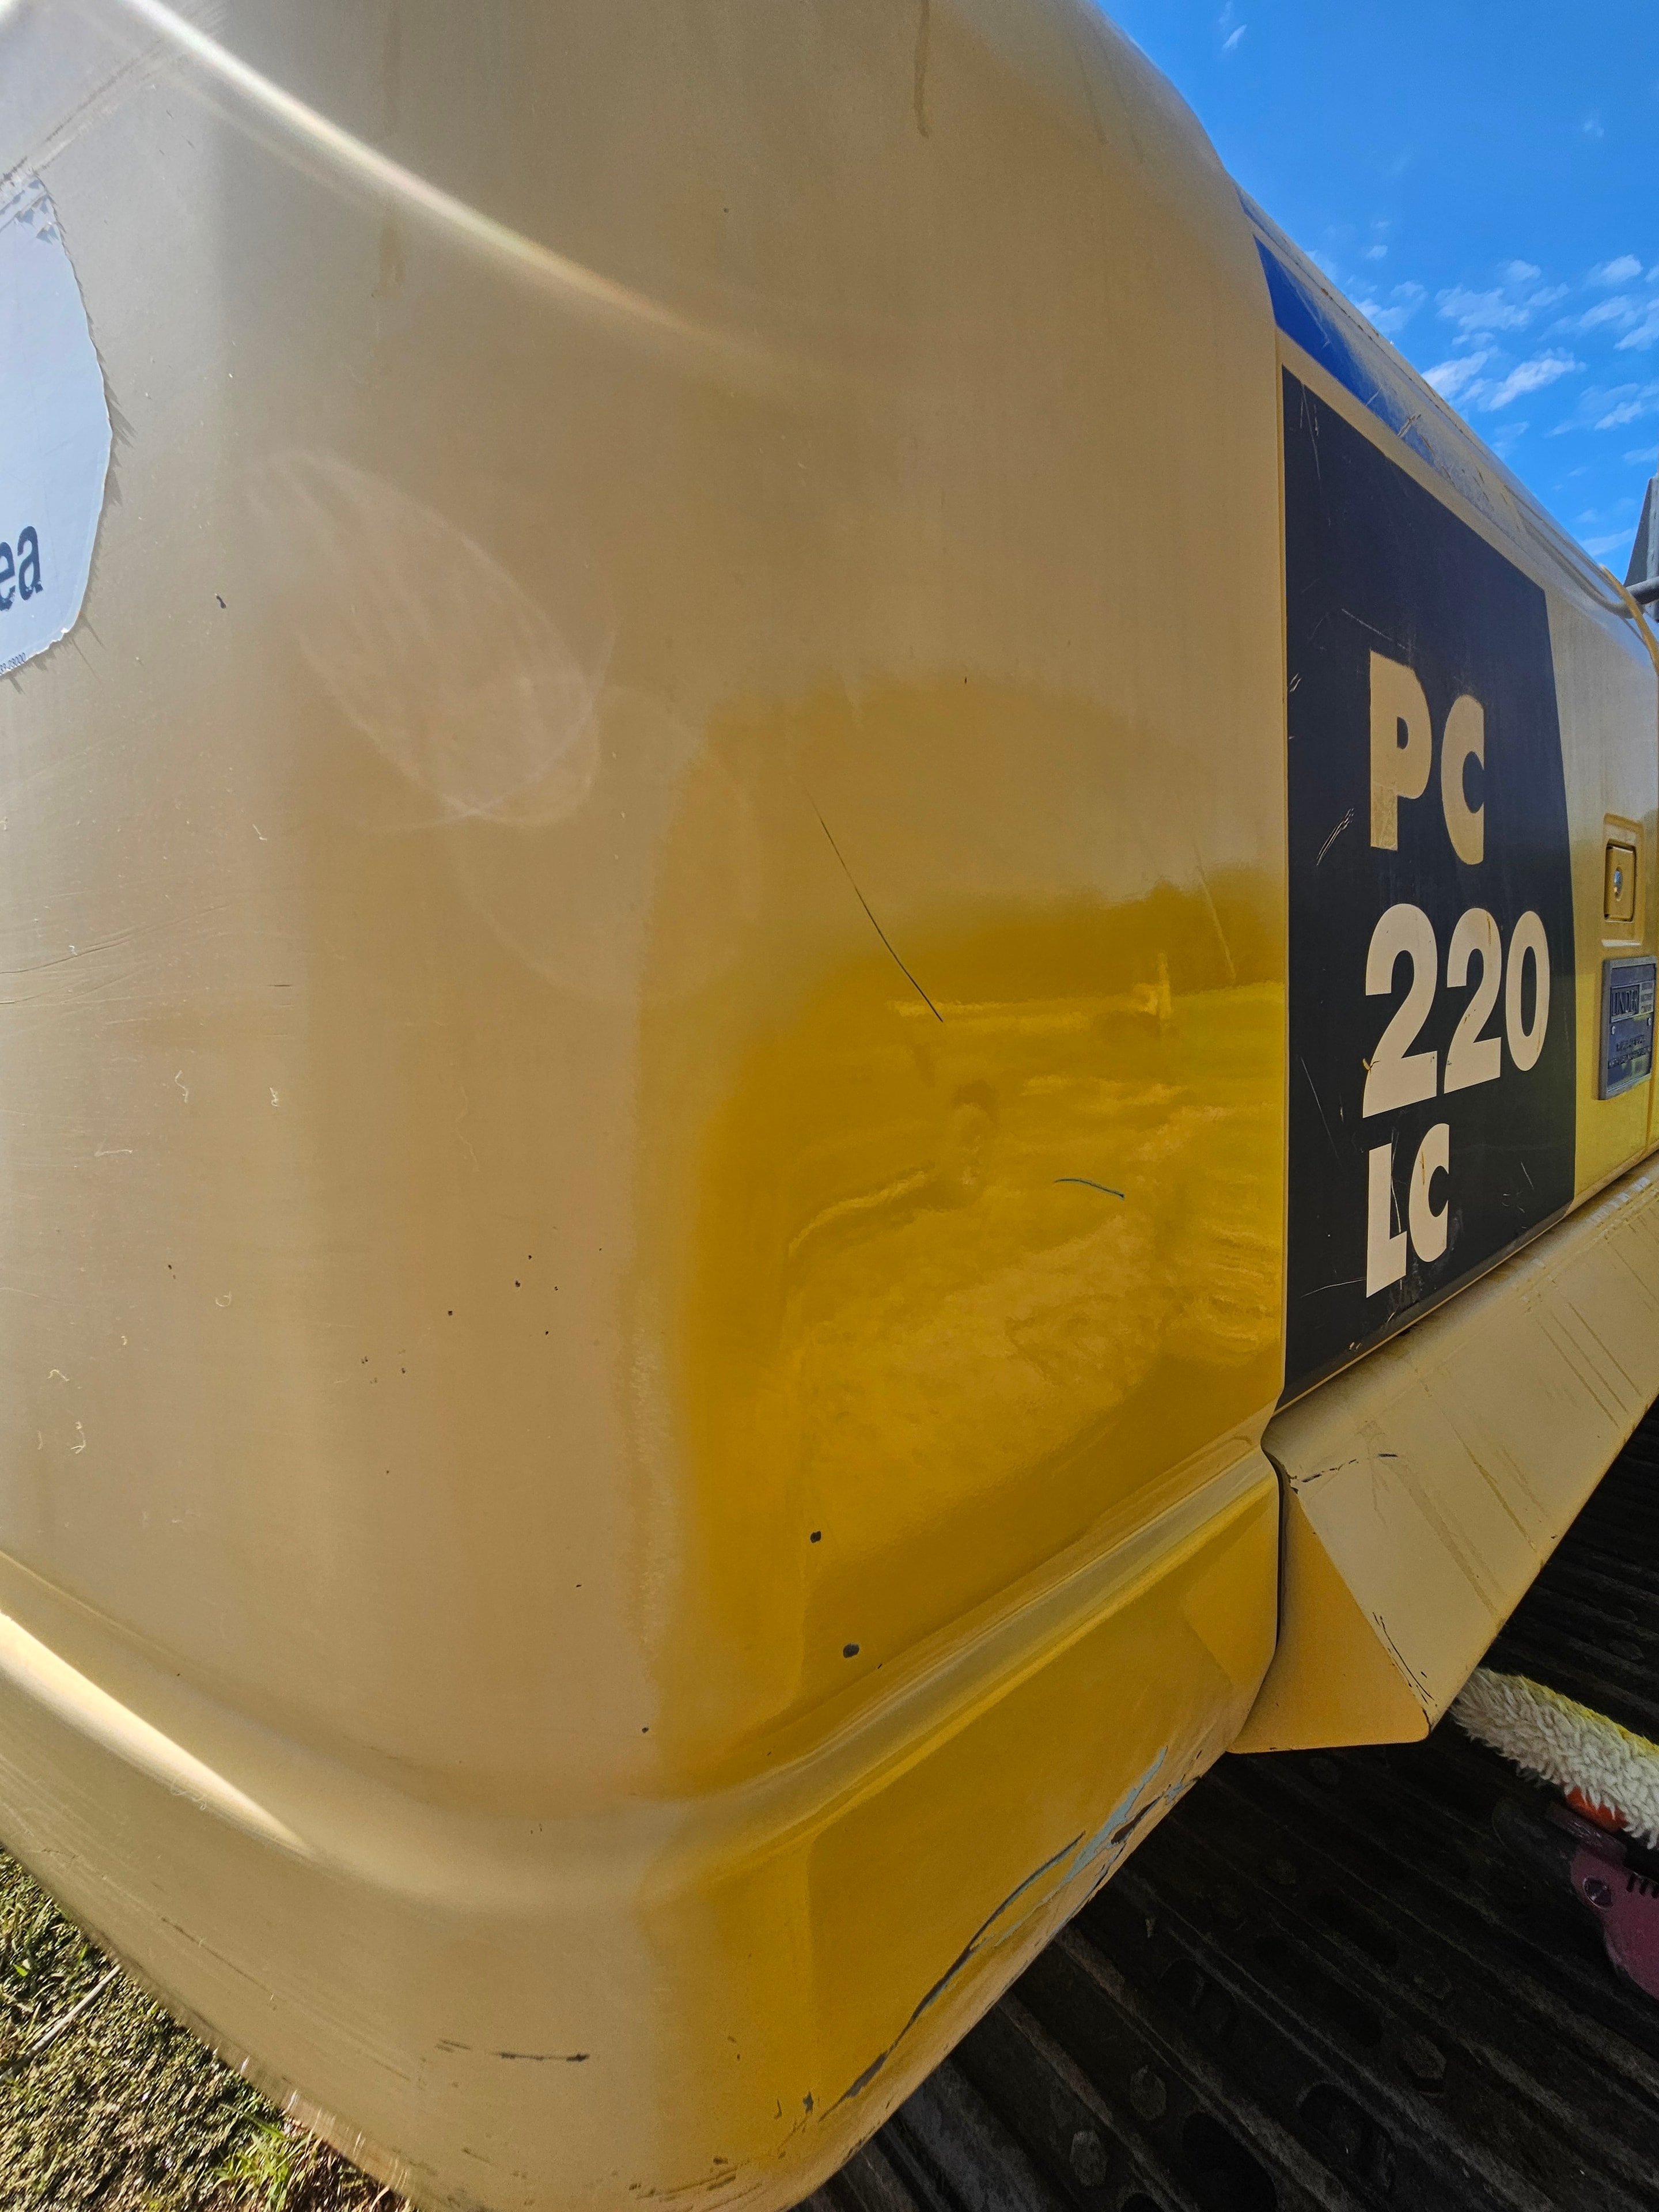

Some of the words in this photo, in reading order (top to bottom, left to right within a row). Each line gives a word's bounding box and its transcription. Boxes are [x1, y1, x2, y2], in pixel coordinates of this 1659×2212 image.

[1370, 649, 1485, 865] PC
[1362, 903, 1550, 1118] 220
[1366, 1123, 1449, 1298] LC
